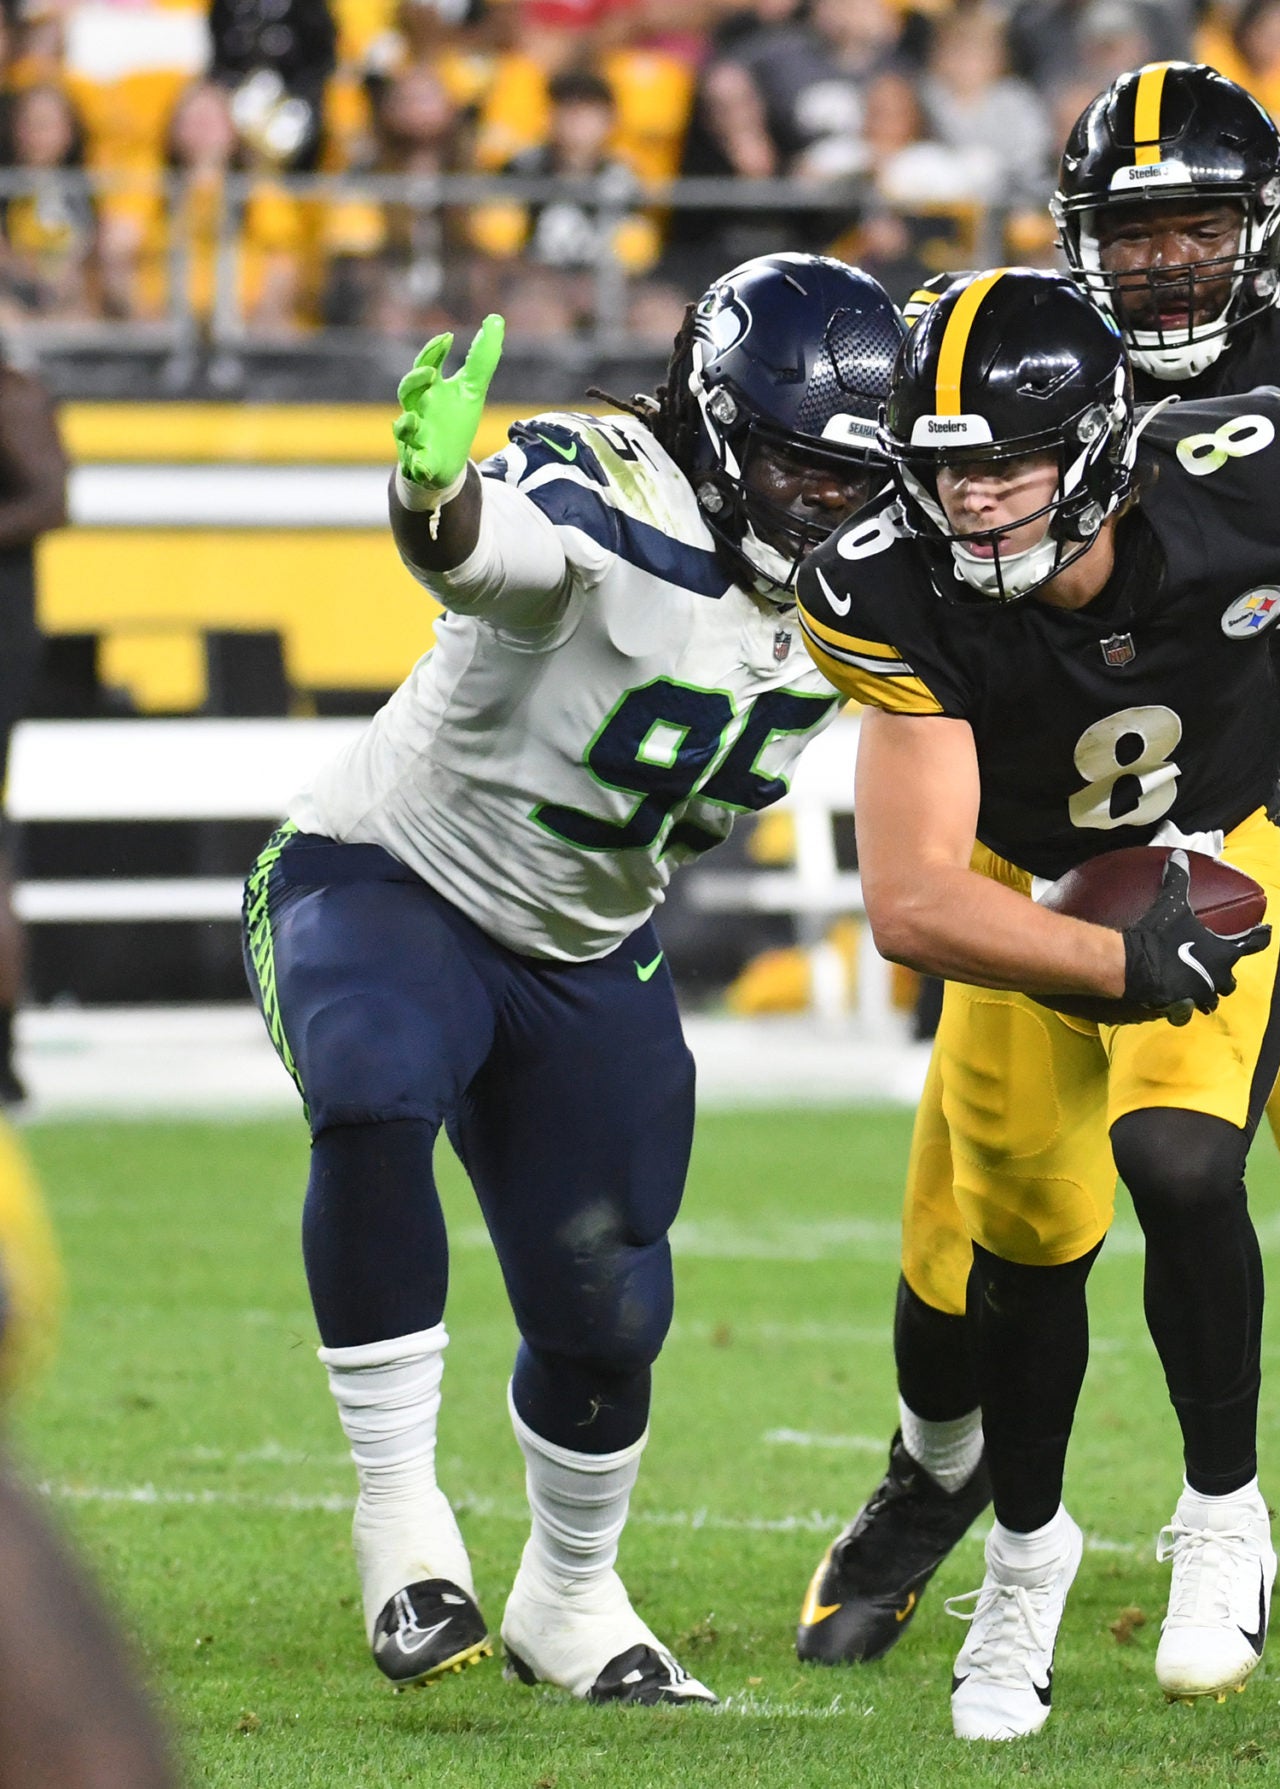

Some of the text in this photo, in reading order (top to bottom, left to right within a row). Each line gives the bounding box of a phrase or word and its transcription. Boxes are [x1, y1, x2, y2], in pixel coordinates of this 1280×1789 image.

[849, 421, 877, 437] SEAHA
[928, 420, 967, 433] Steelers
[1176, 414, 1276, 476] 8
[527, 674, 844, 864] 95
[1068, 705, 1183, 831] 8
